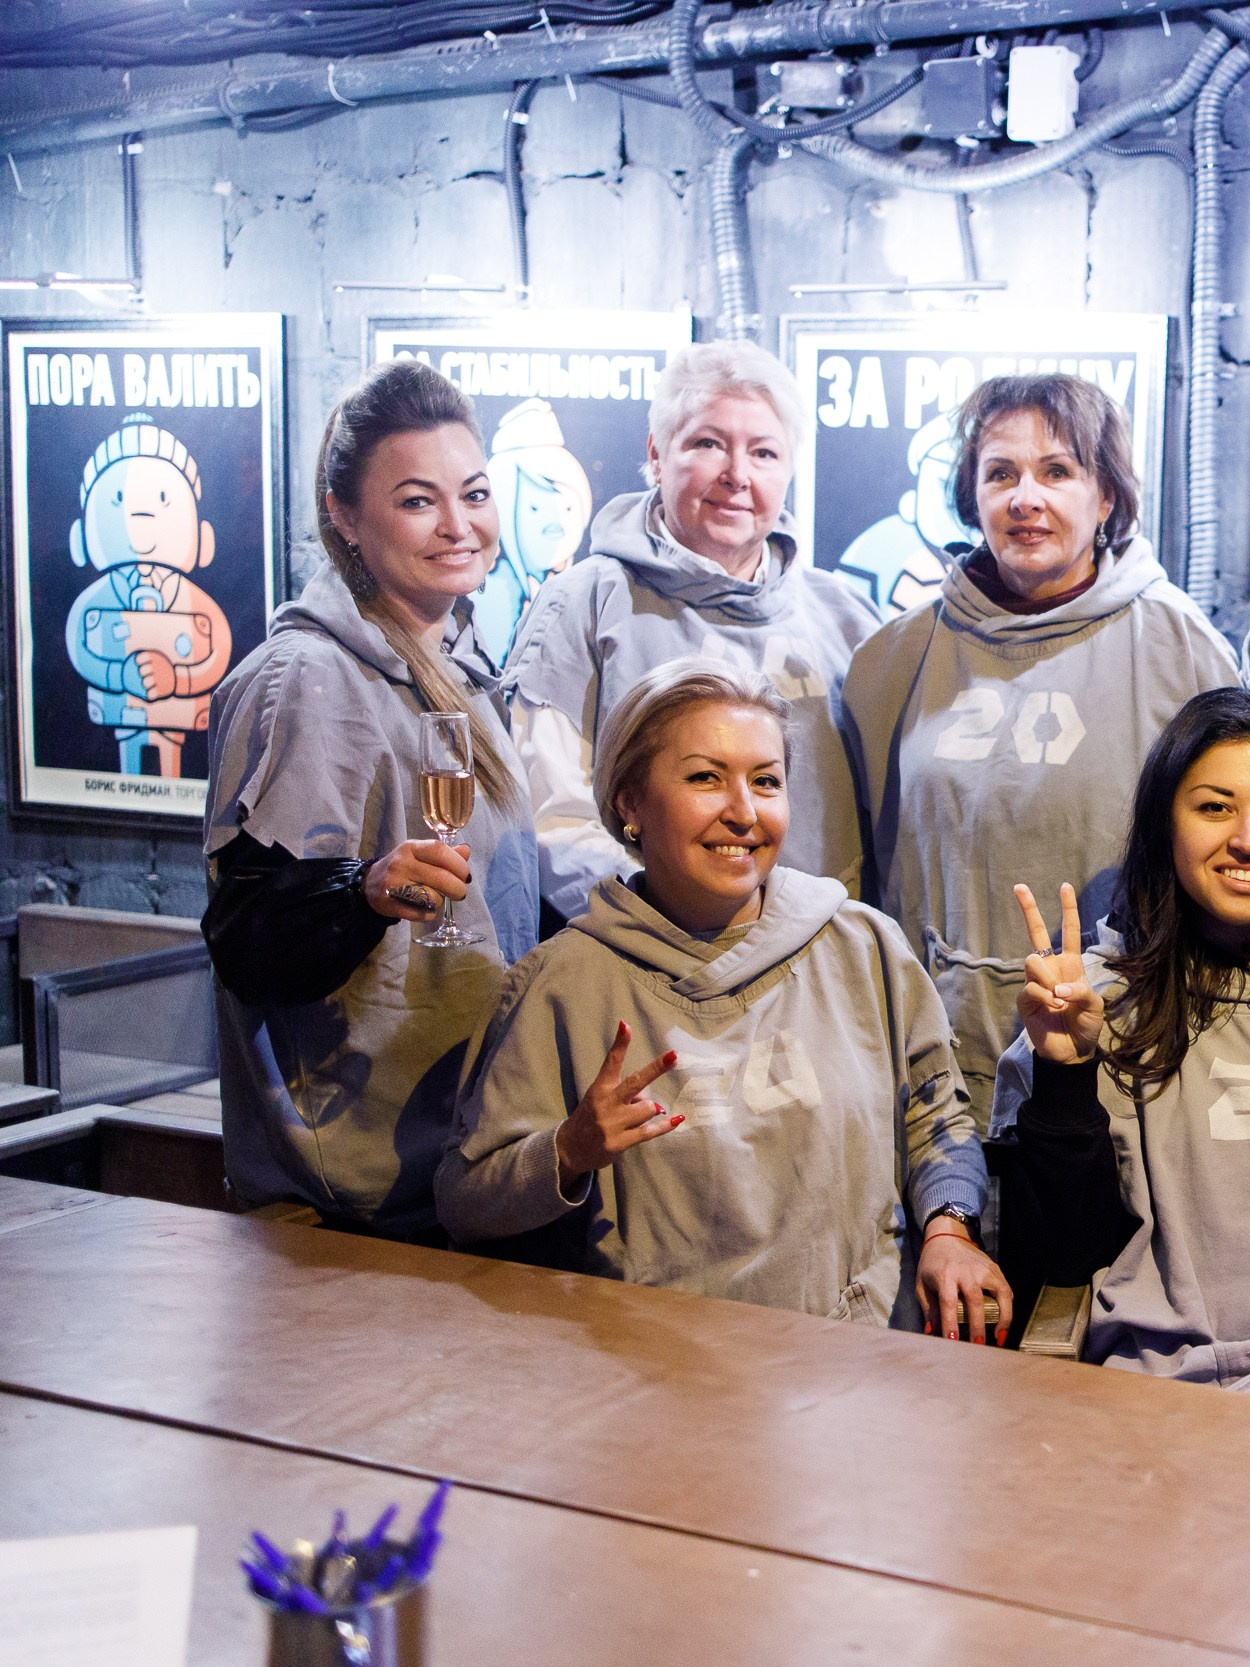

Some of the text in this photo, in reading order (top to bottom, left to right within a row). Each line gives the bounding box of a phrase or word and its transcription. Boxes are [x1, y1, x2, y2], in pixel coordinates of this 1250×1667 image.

[27, 353, 261, 408] ПОРА ВАЛИТЬ
[818, 355, 889, 428] ЗА
[933, 688, 1087, 765] 20
[84, 778, 116, 793] БОРИС
[118, 781, 172, 797] ФРИДМАН
